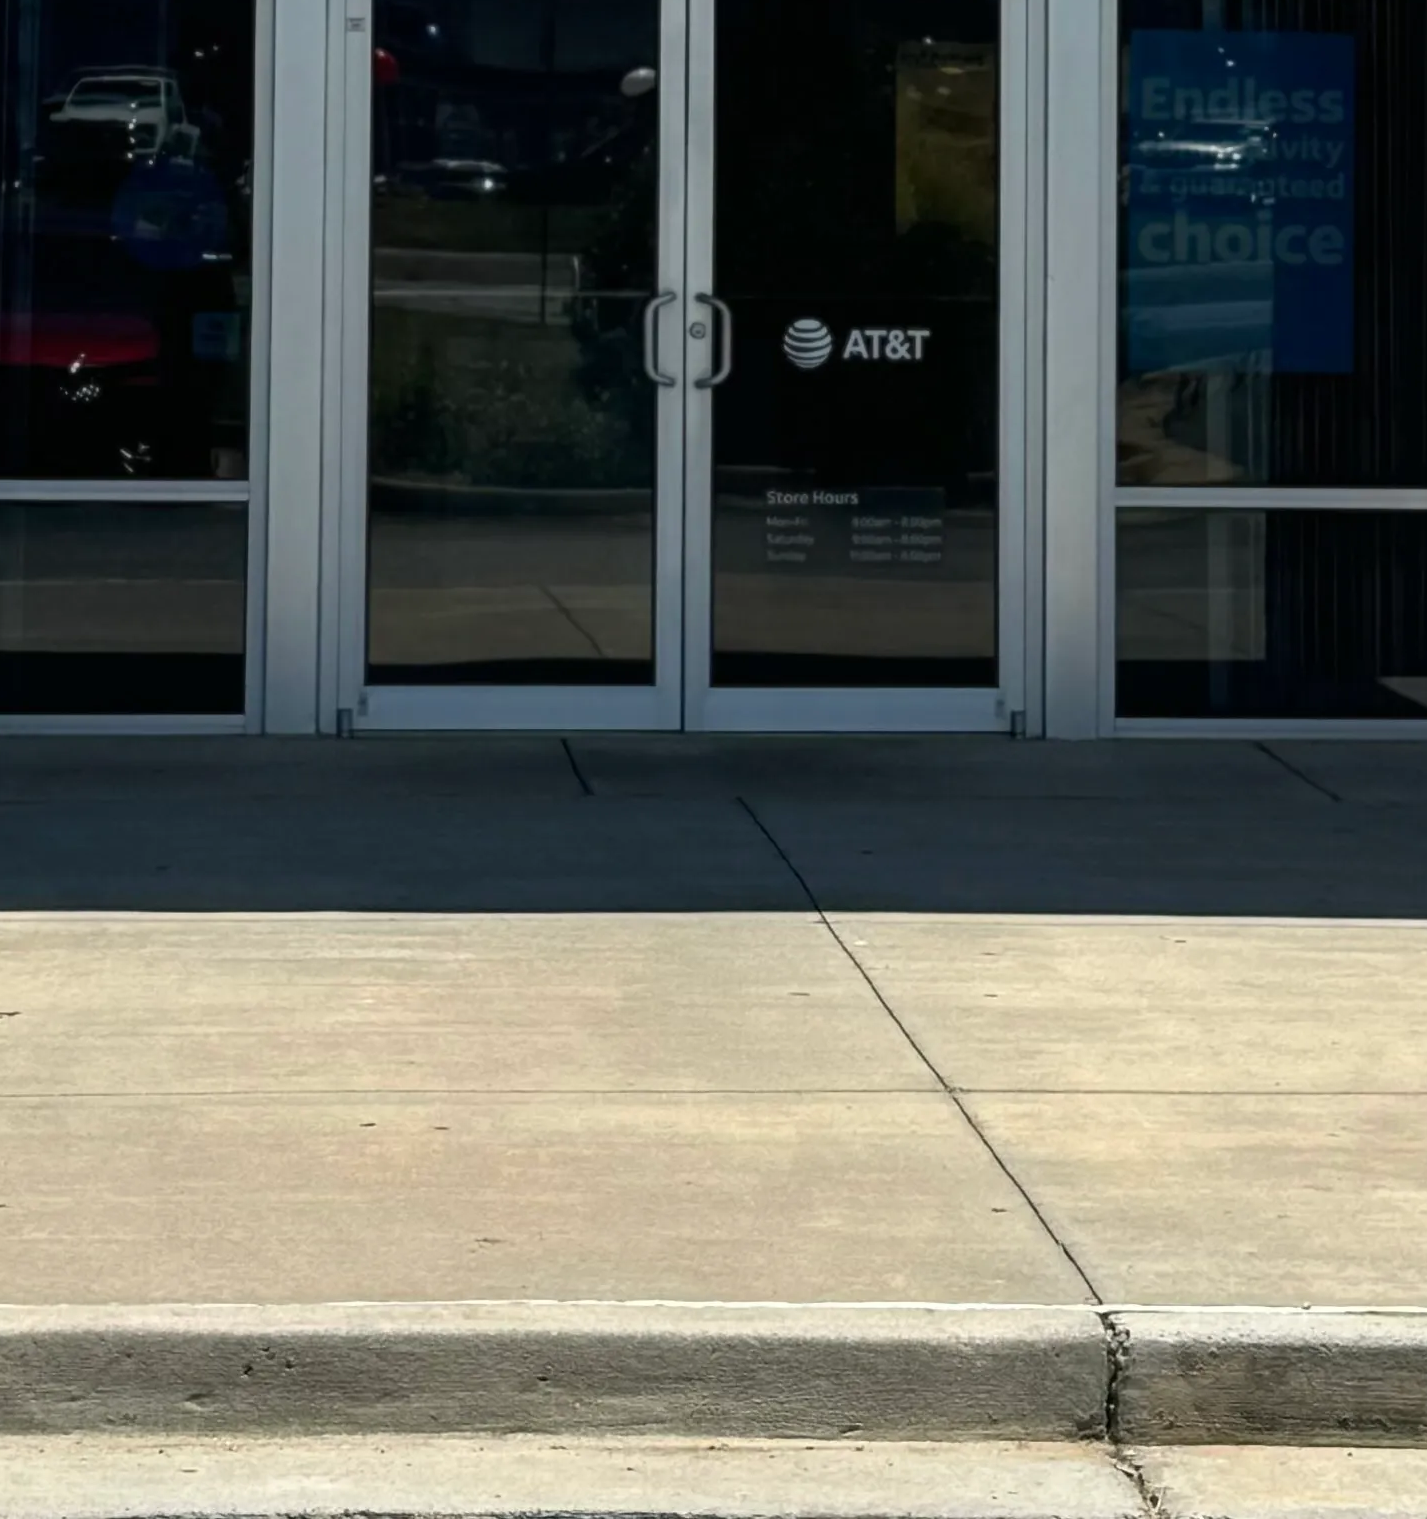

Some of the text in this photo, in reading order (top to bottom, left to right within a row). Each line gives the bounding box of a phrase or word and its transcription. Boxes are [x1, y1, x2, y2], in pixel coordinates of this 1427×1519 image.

[1141, 76, 1344, 123] Endless
[1137, 208, 1345, 265] choice
[842, 329, 931, 360] AT&T
[766, 490, 859, 505] Store Hours
